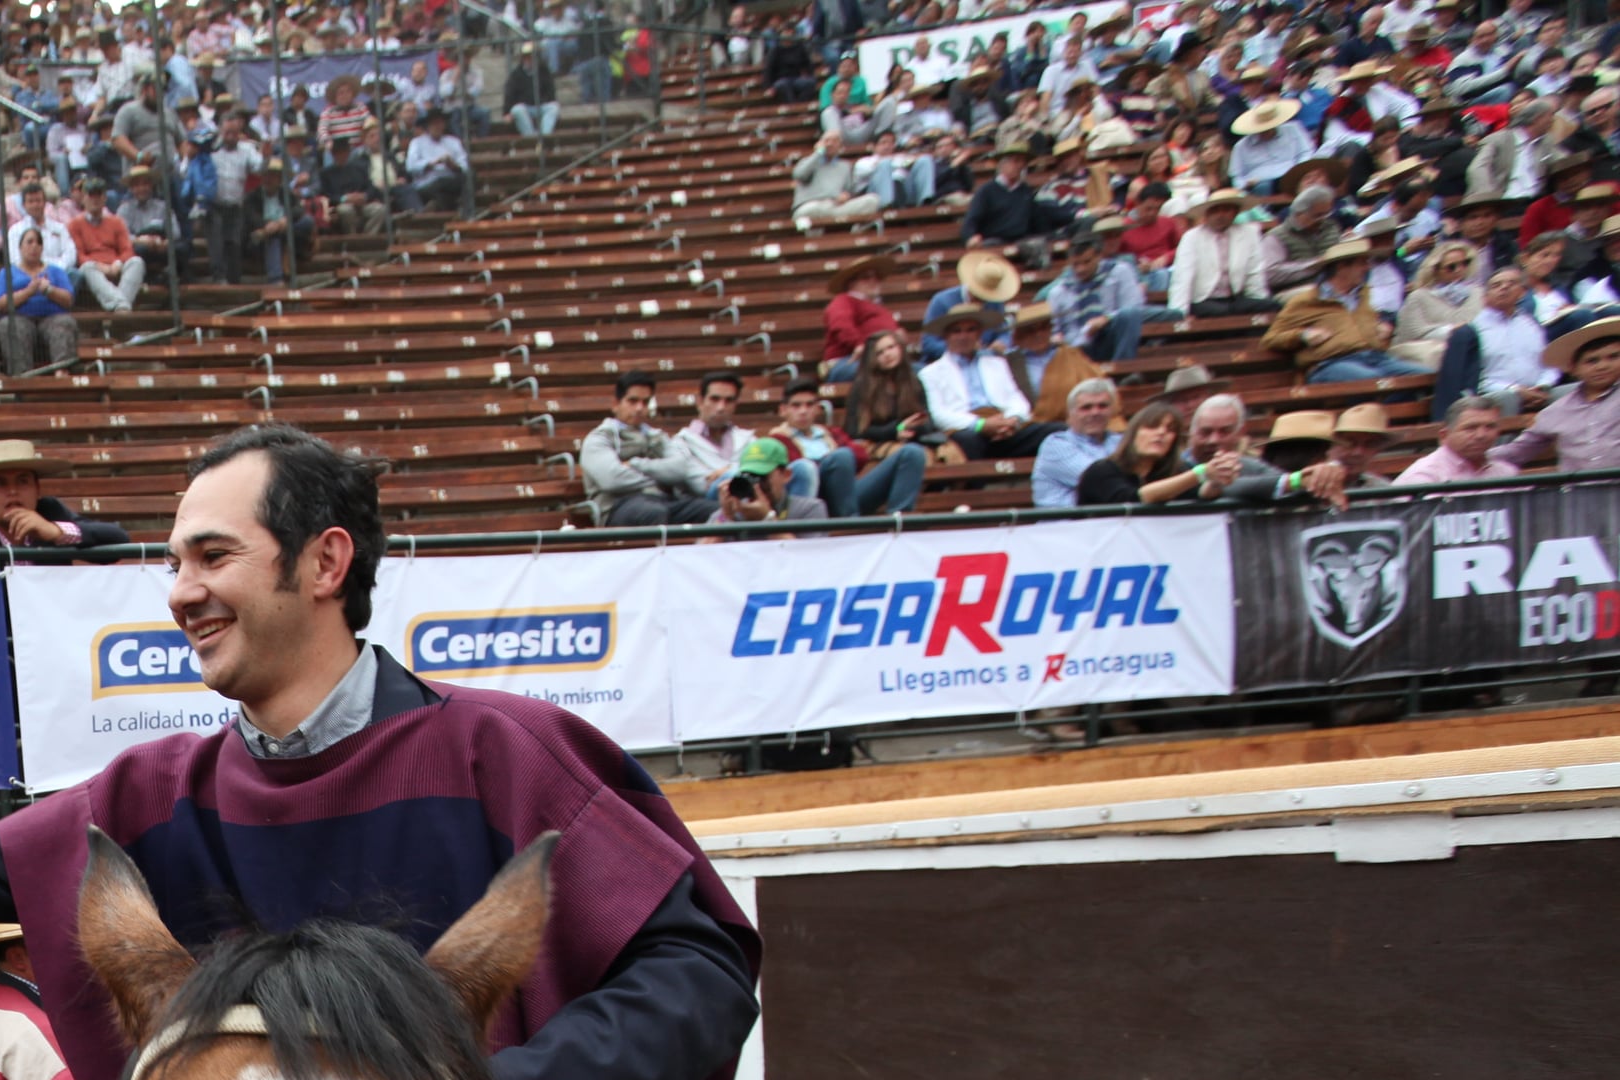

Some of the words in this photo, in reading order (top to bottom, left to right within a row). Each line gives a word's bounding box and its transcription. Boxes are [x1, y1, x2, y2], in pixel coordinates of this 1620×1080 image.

[1433, 509, 1511, 546] NUEVA
[1433, 536, 1620, 600] RA
[1520, 590, 1620, 647] ECOD
[419, 620, 602, 664] Ceresita
[880, 662, 1007, 694] Llegamos
[1017, 664, 1031, 681] a
[1042, 652, 1176, 687] Rancagua
[545, 688, 560, 704] lo
[564, 687, 623, 704] mismo
[92, 714, 112, 732] La
[118, 709, 183, 731] calidad
[189, 713, 213, 727] no
